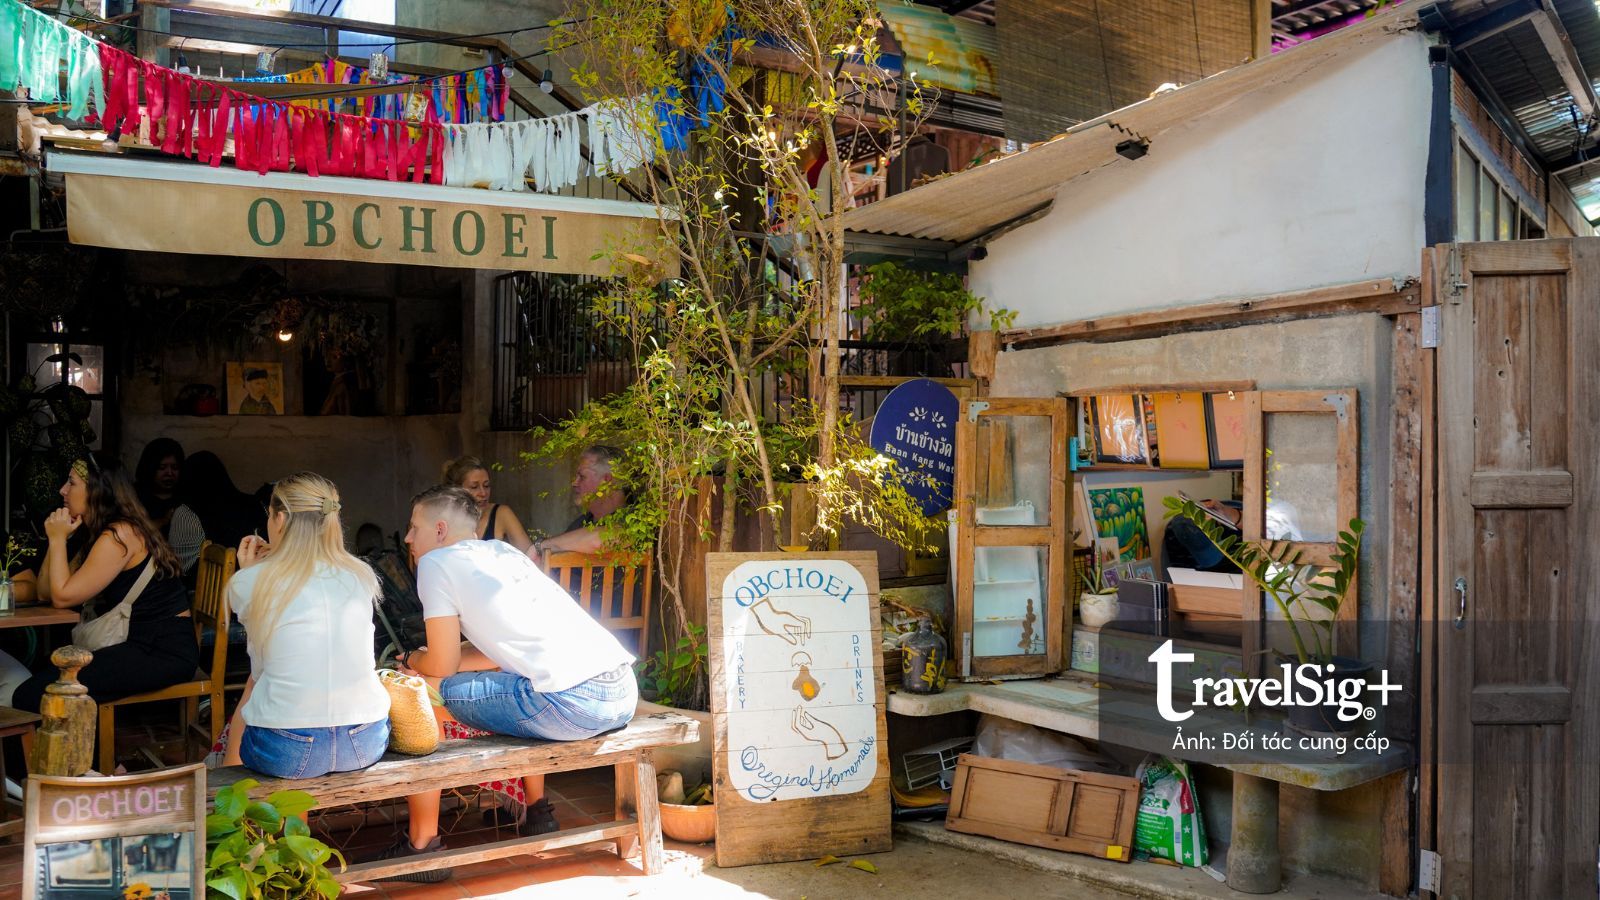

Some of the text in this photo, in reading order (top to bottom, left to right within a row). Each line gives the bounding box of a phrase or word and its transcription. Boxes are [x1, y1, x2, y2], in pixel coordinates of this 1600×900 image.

[247, 197, 558, 260] OBCHOEI
[885, 443, 908, 458] Baan
[912, 452, 934, 469] Kang
[735, 567, 855, 608] OBCHOEI
[736, 641, 746, 710] BAKERY
[852, 634, 864, 703] DRINKS
[741, 735, 875, 799] Original Homemade
[52, 784, 187, 825] OBCHOEI
